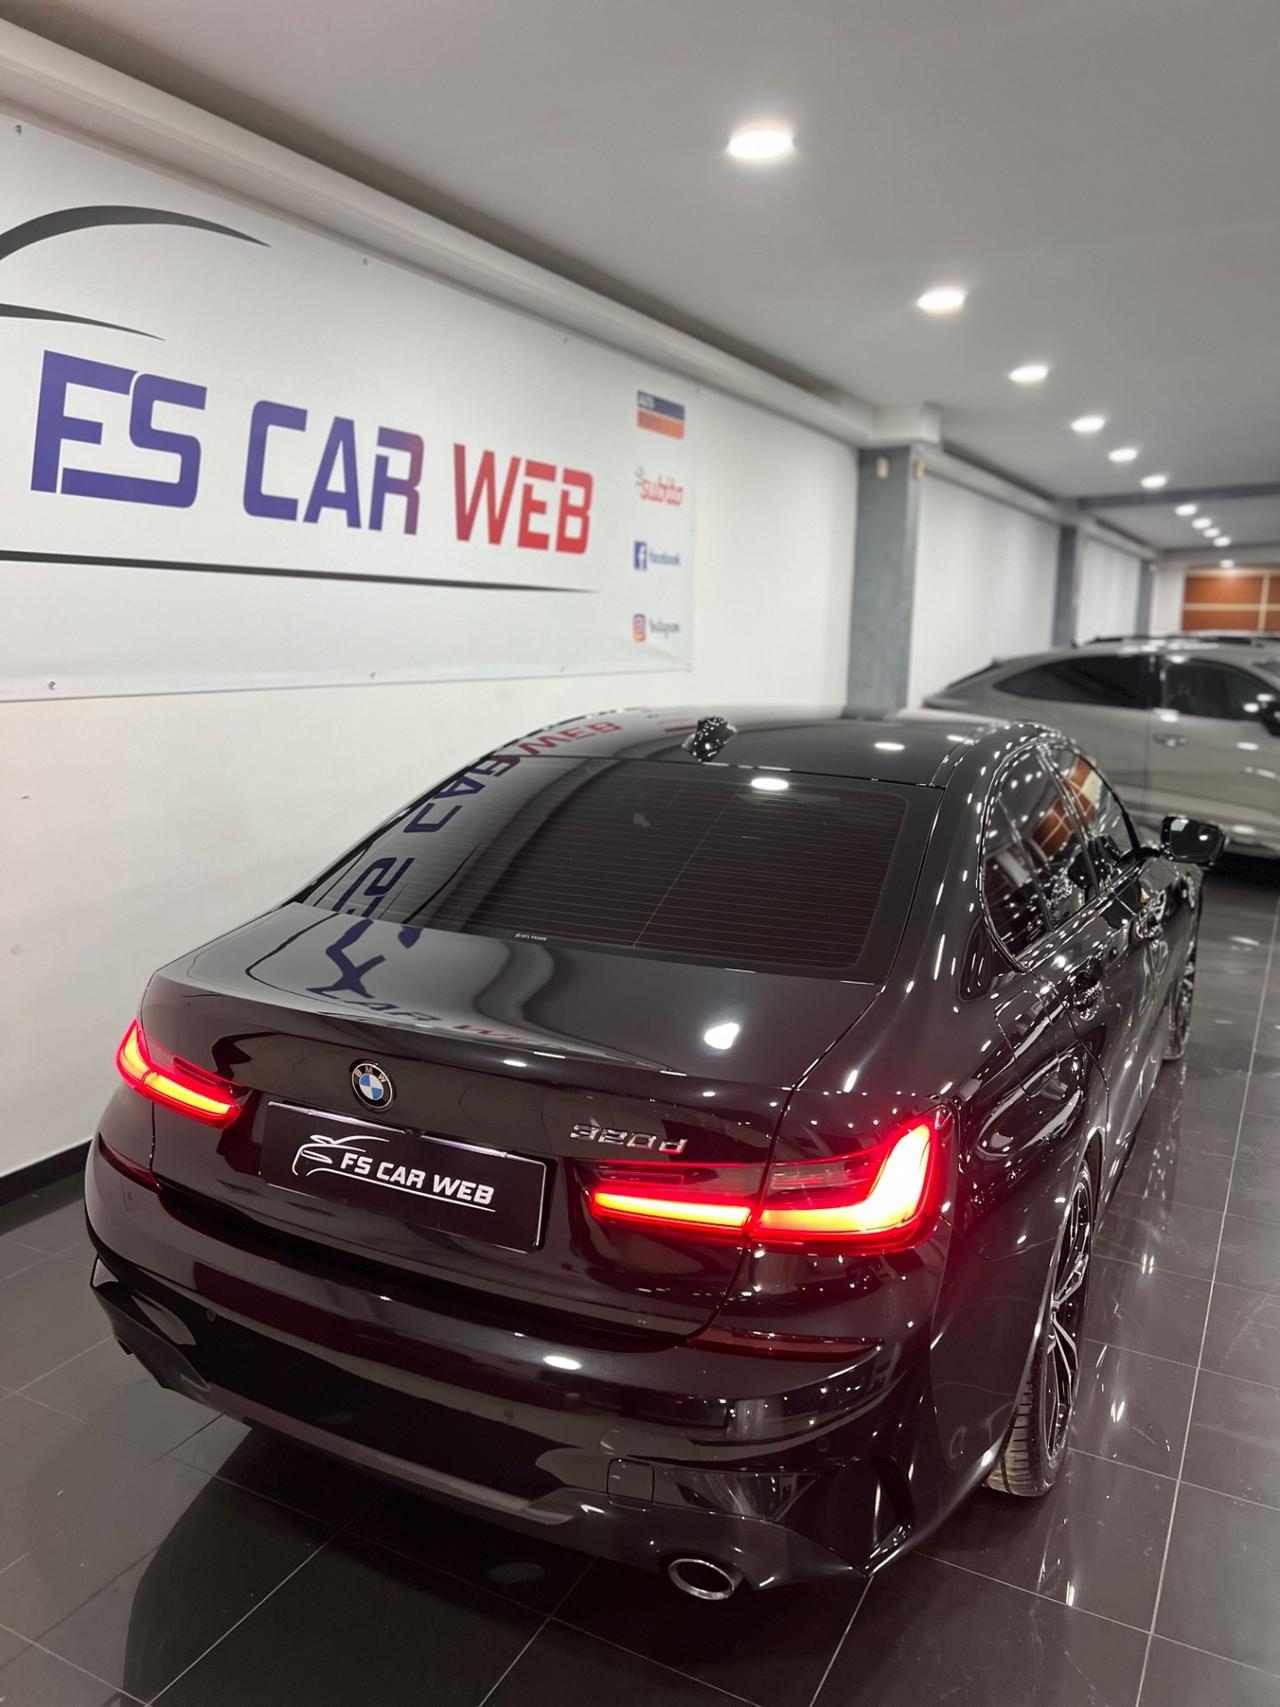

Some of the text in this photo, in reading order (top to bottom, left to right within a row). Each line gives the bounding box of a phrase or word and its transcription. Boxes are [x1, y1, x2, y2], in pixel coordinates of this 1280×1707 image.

[30, 350, 594, 555] FS CAR WEB
[354, 1065, 387, 1083] BMW
[569, 1125, 688, 1154] 320d
[340, 1152, 494, 1205] FS CAR WEB
